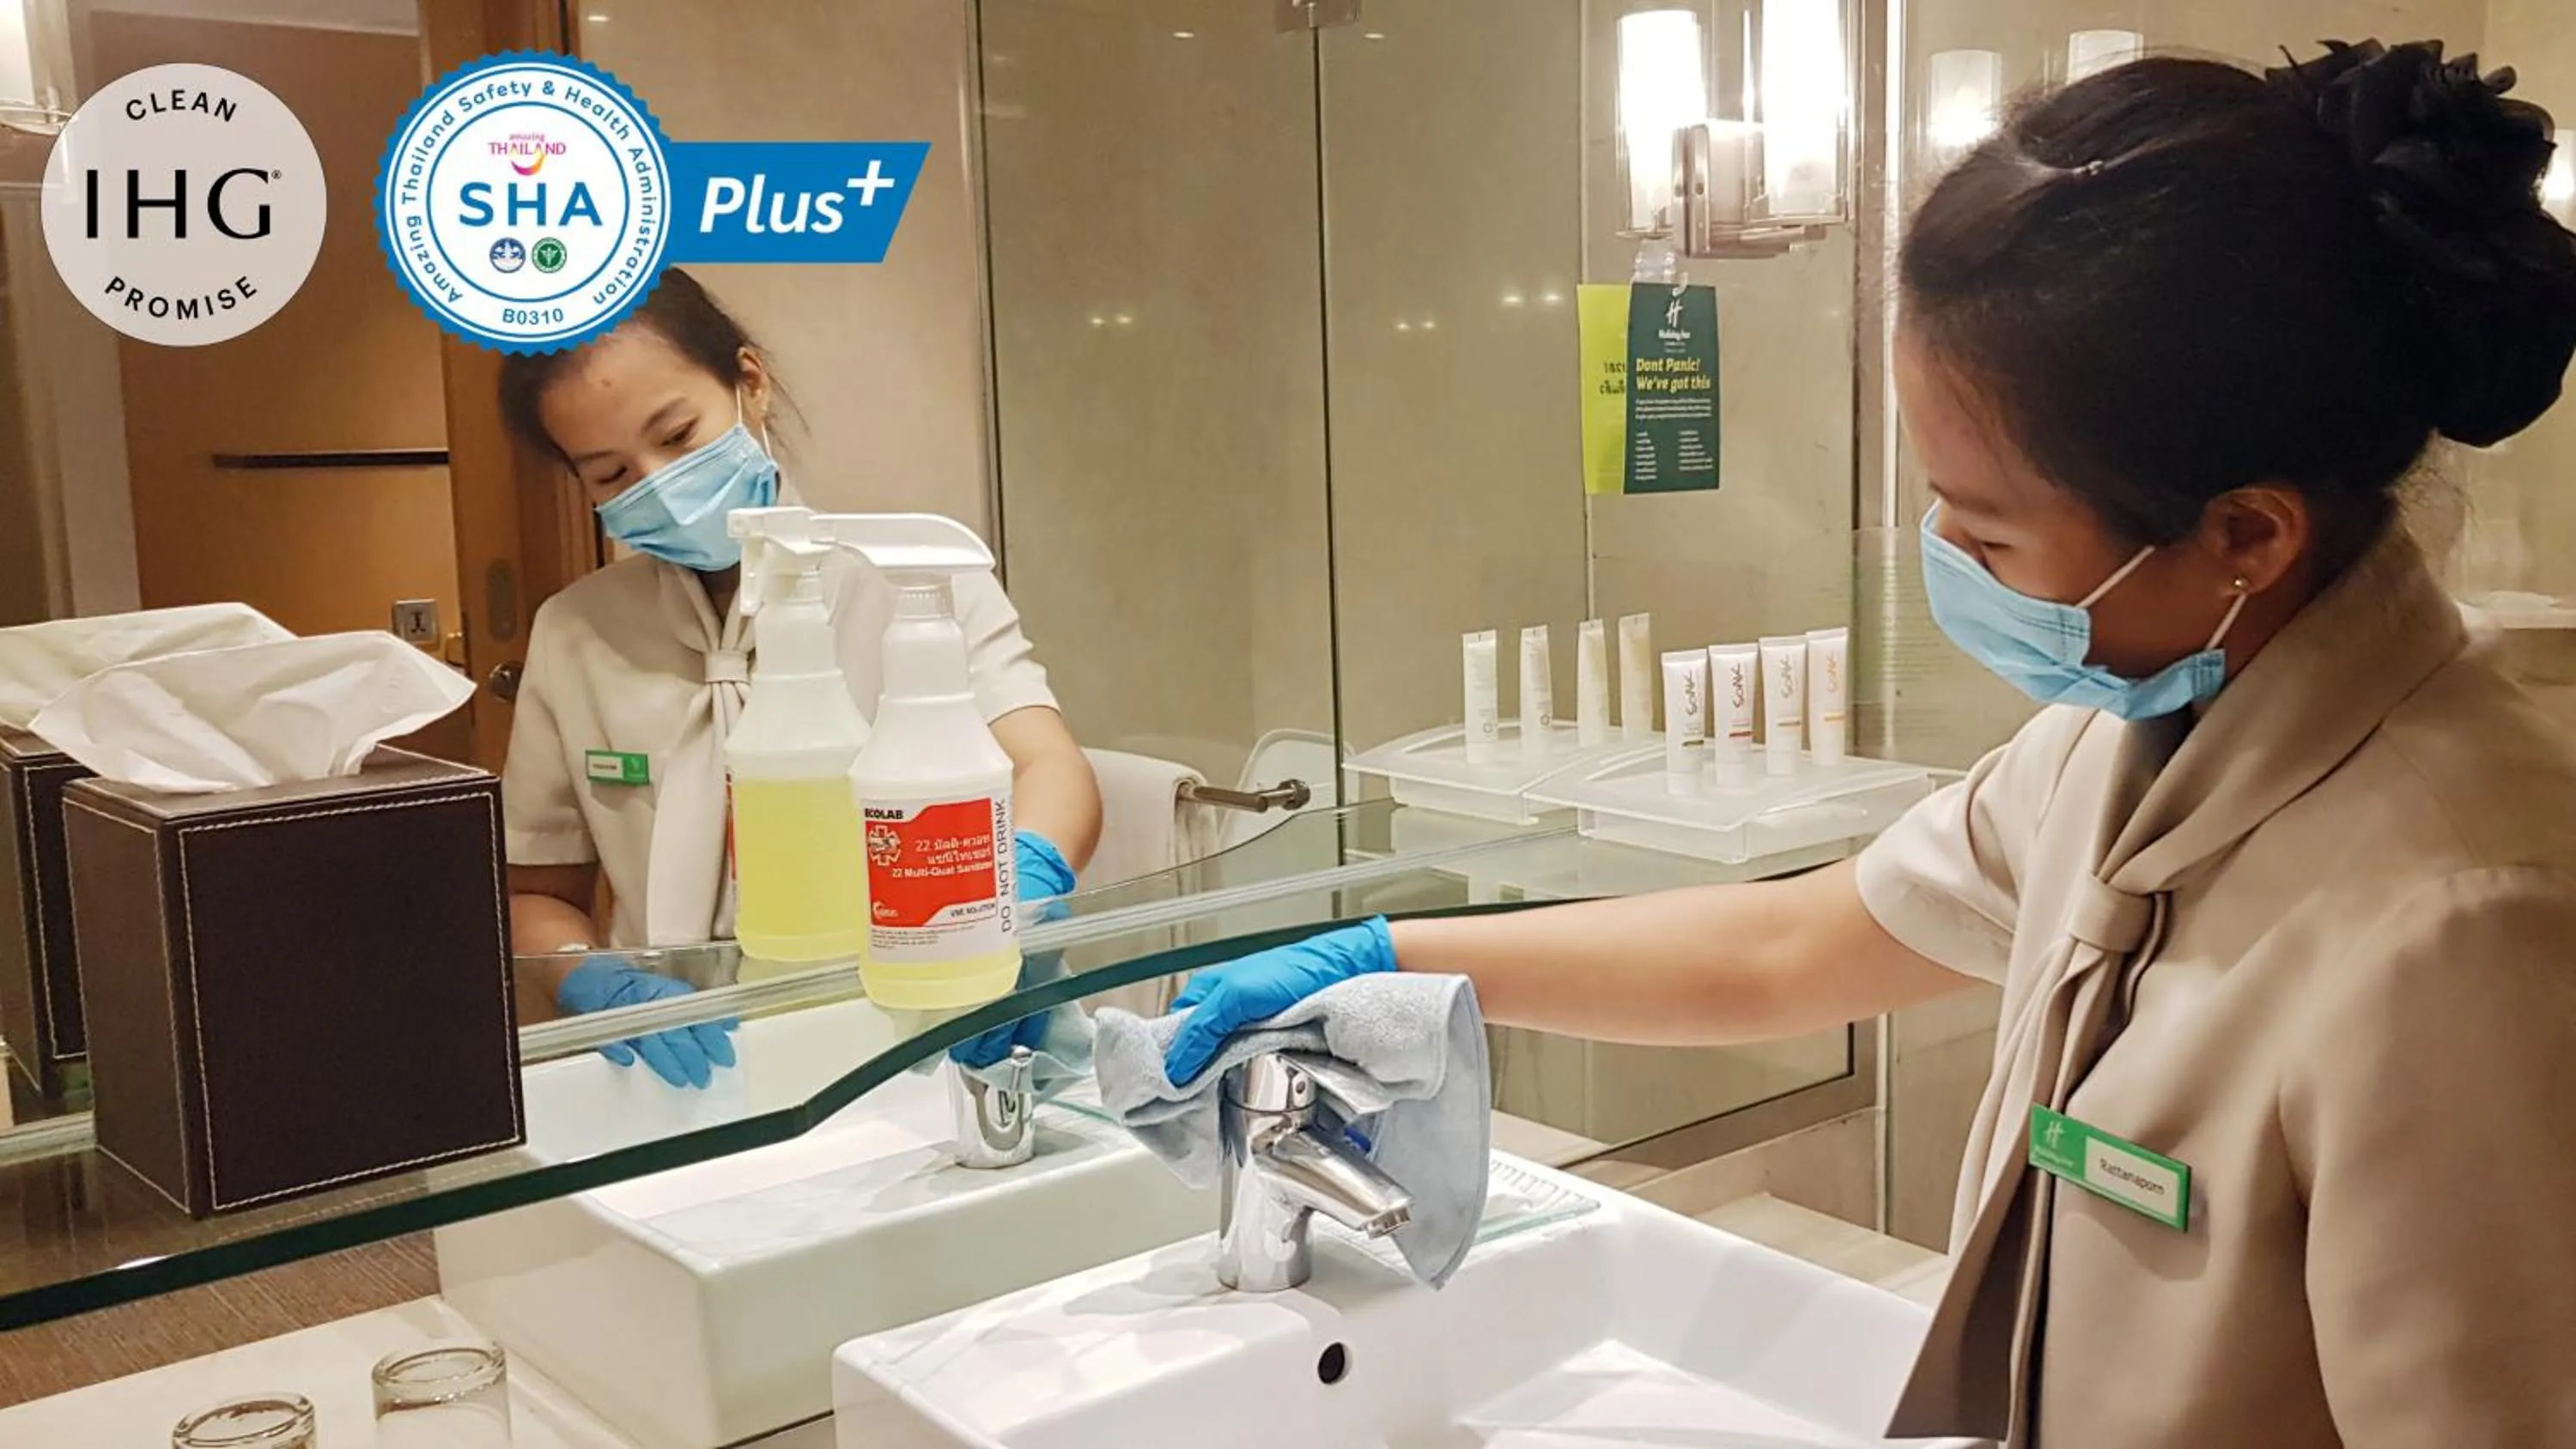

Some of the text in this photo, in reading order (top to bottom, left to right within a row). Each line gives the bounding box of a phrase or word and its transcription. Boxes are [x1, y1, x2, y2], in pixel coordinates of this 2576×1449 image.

[1636, 375, 1669, 391] We've
[1670, 377, 1689, 394] got
[1690, 375, 1711, 389] this
[865, 808, 904, 820] ECOLAB
[915, 839, 931, 852] 22
[994, 798, 1012, 933] DO NOT DRINK
[892, 868, 902, 878] 22
